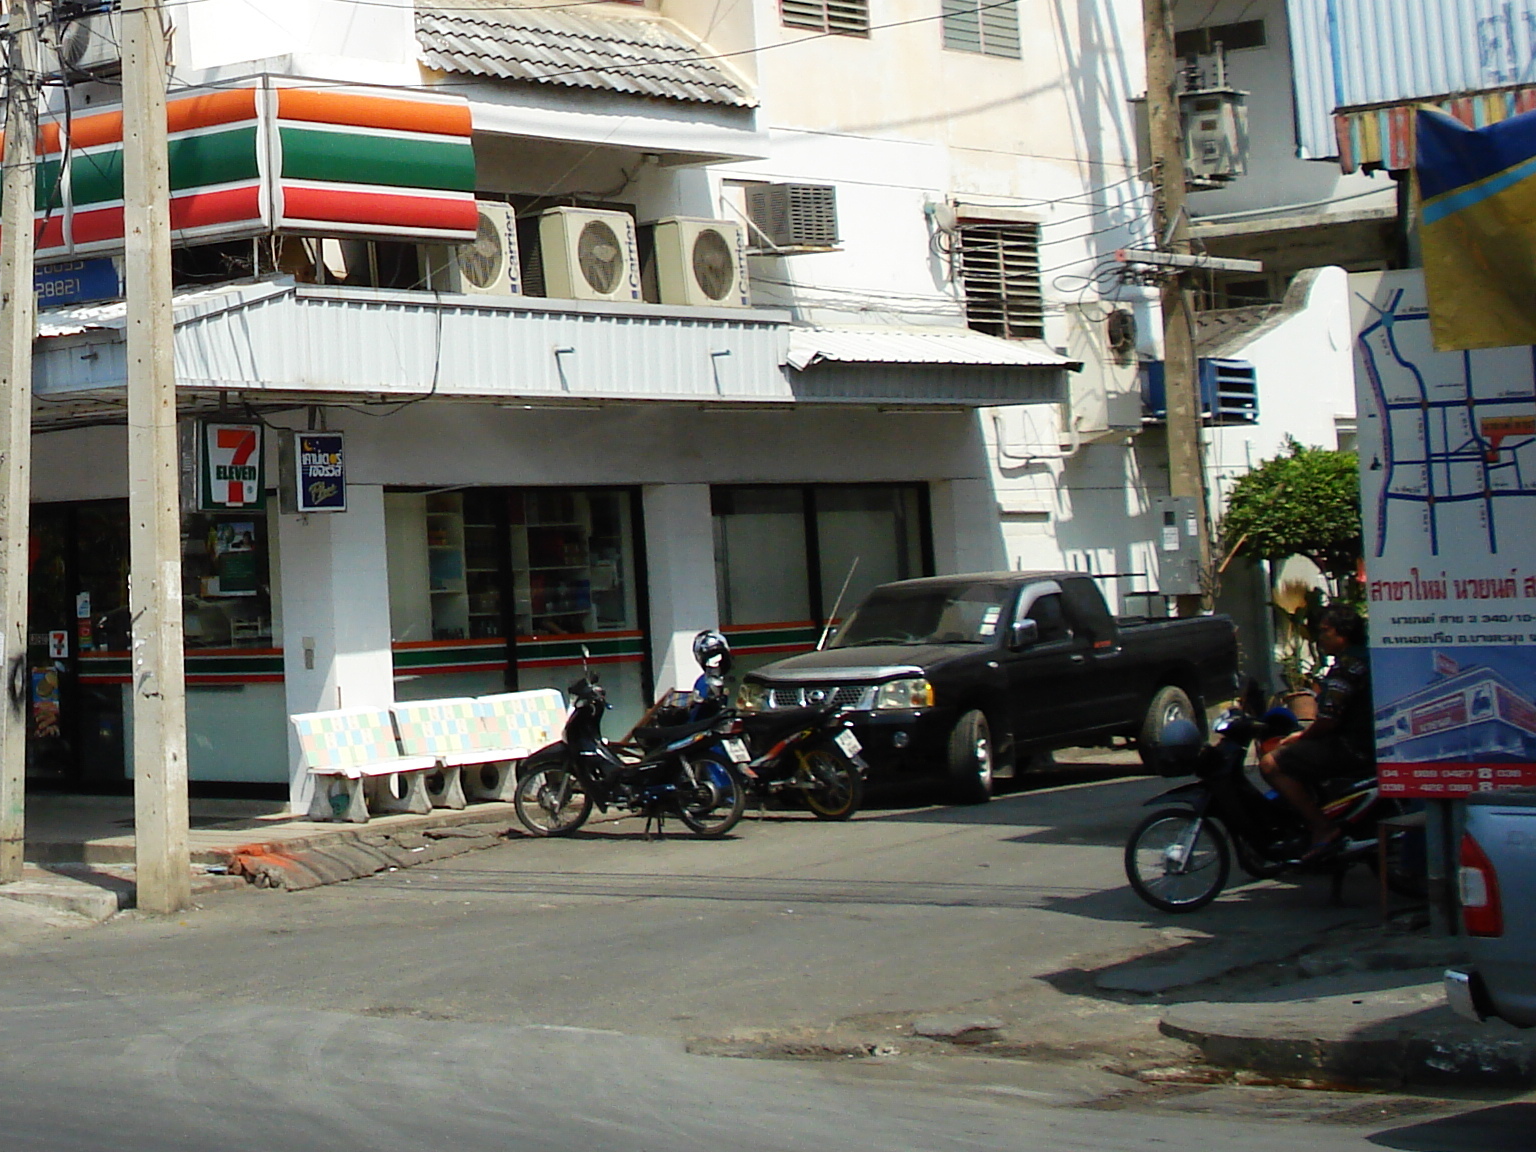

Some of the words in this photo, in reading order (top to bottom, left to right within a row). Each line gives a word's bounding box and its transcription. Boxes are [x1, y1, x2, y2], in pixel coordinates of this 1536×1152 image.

[504, 211, 520, 283] Carrier
[624, 221, 640, 289] Carrier
[734, 229, 748, 294] Carrier
[218, 429, 255, 503] 7
[1371, 567, 1446, 601] สาขาใหม่
